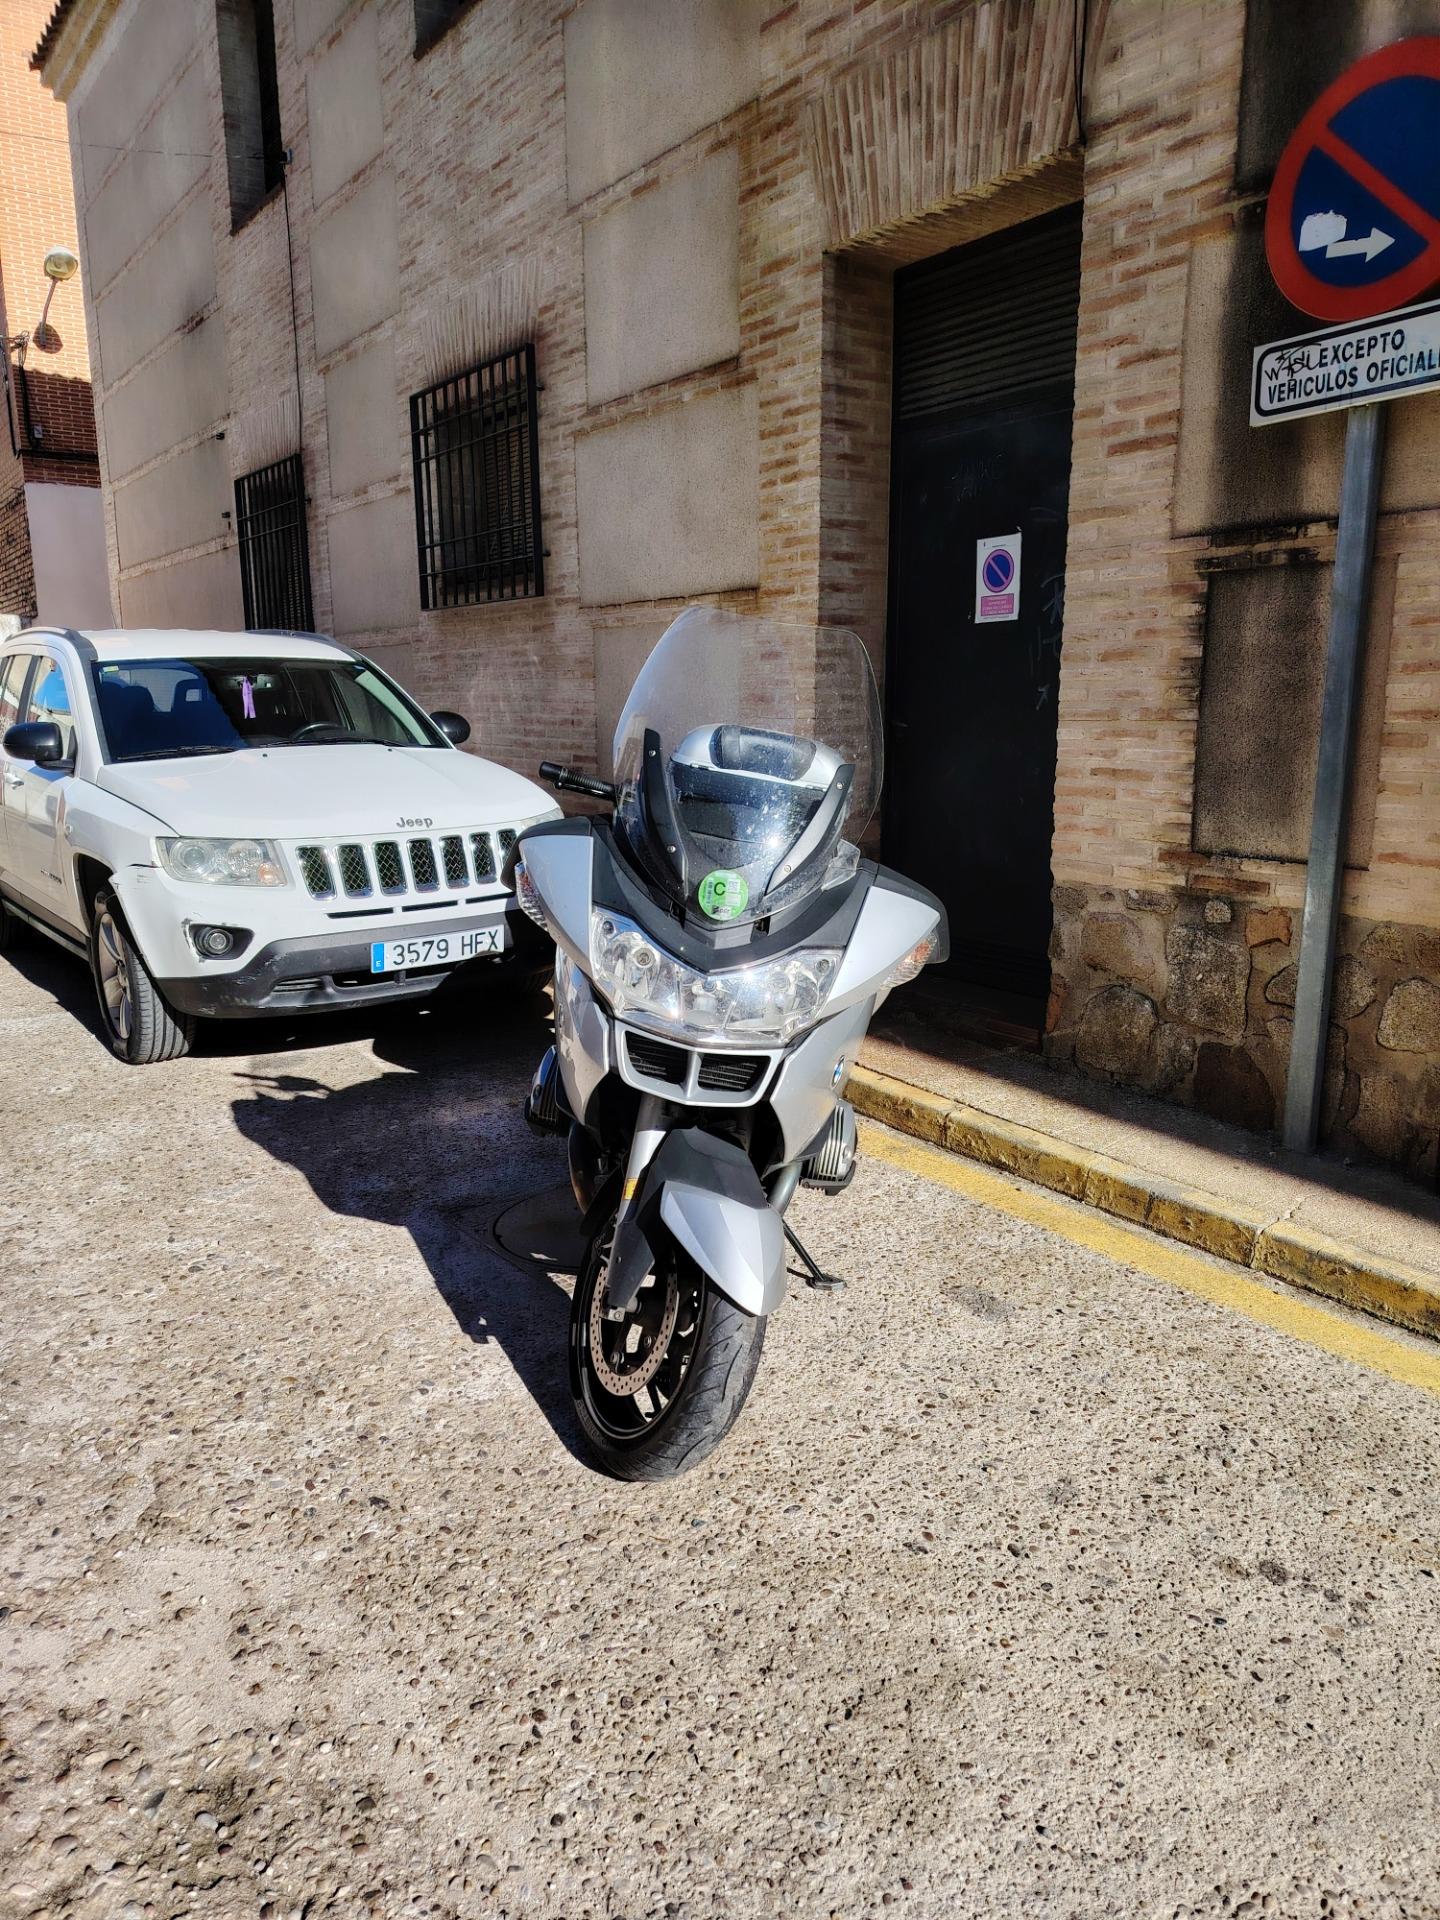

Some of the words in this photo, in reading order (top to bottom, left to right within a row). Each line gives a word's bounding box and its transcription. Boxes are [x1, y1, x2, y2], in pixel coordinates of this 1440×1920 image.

[1319, 329, 1405, 368] EXCEPTO
[1268, 366, 1358, 404] VEHICULOS
[1366, 346, 1440, 383] OFICIAL
[396, 816, 433, 828] Jeep
[714, 882, 726, 896] C
[393, 938, 449, 966] 3579
[461, 929, 499, 956] HFX
